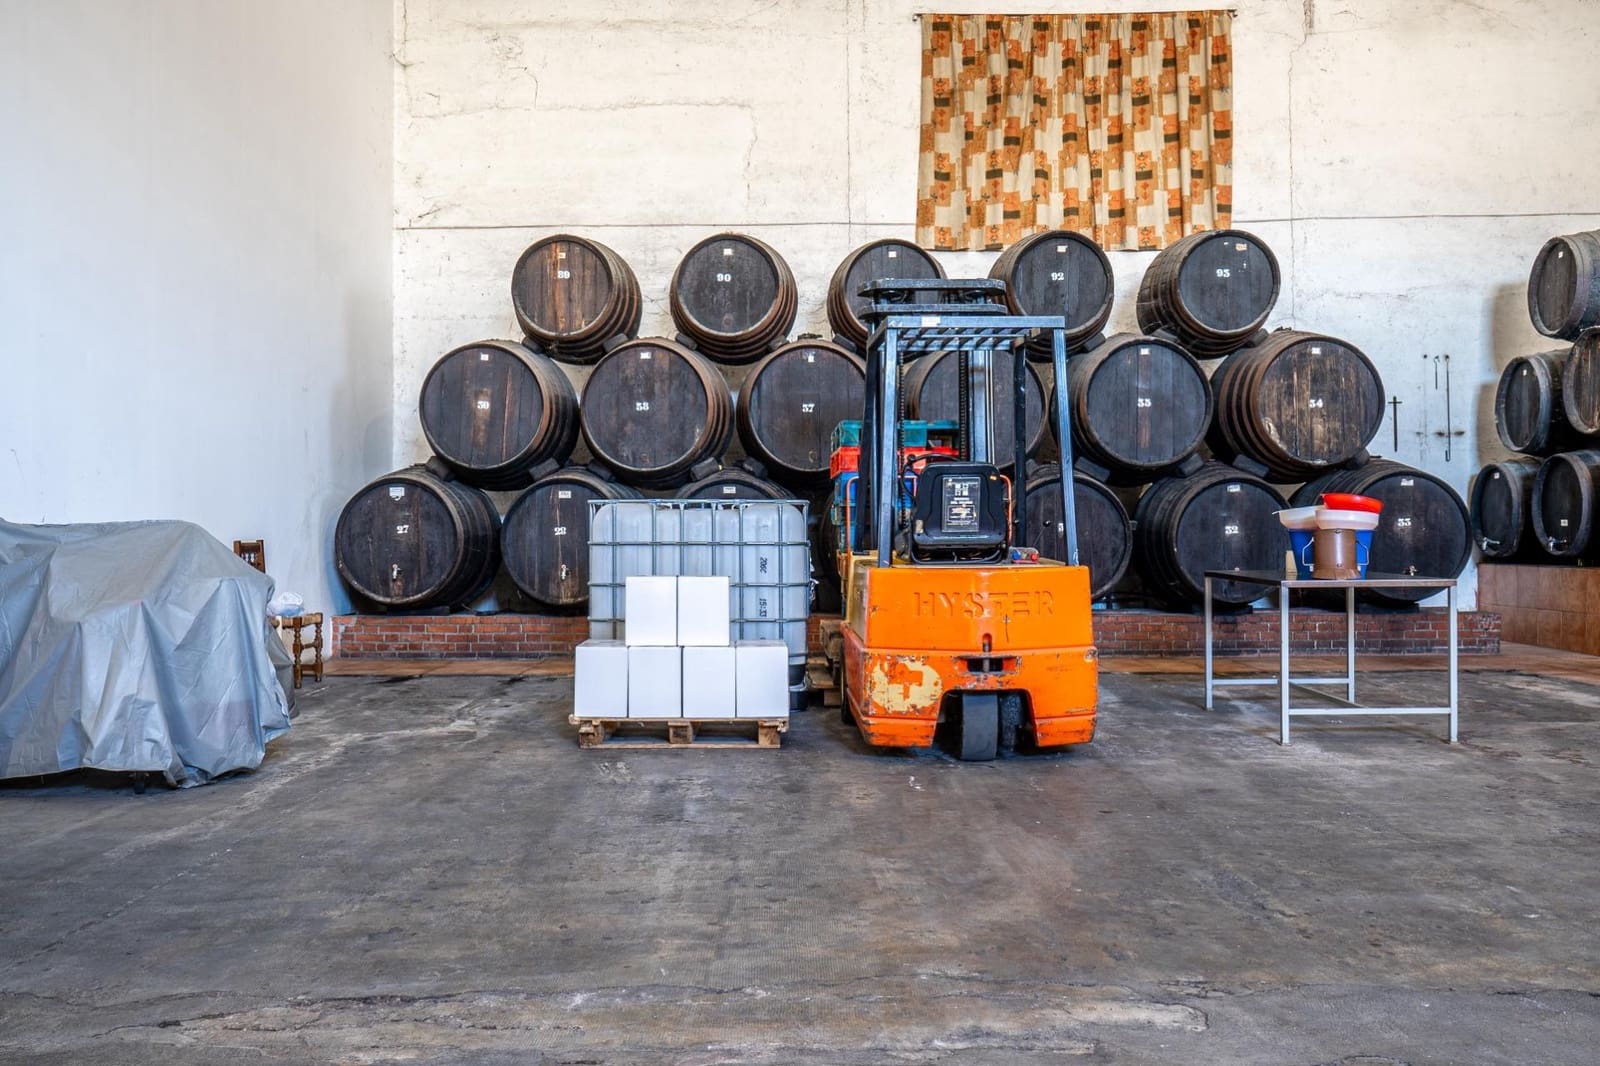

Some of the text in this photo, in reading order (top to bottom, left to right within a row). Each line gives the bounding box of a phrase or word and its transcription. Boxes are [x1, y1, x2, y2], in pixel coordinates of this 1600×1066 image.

[716, 273, 732, 282] 90
[1051, 272, 1065, 281] 92
[396, 525, 410, 534] 27
[913, 591, 1055, 618] HYSTER
